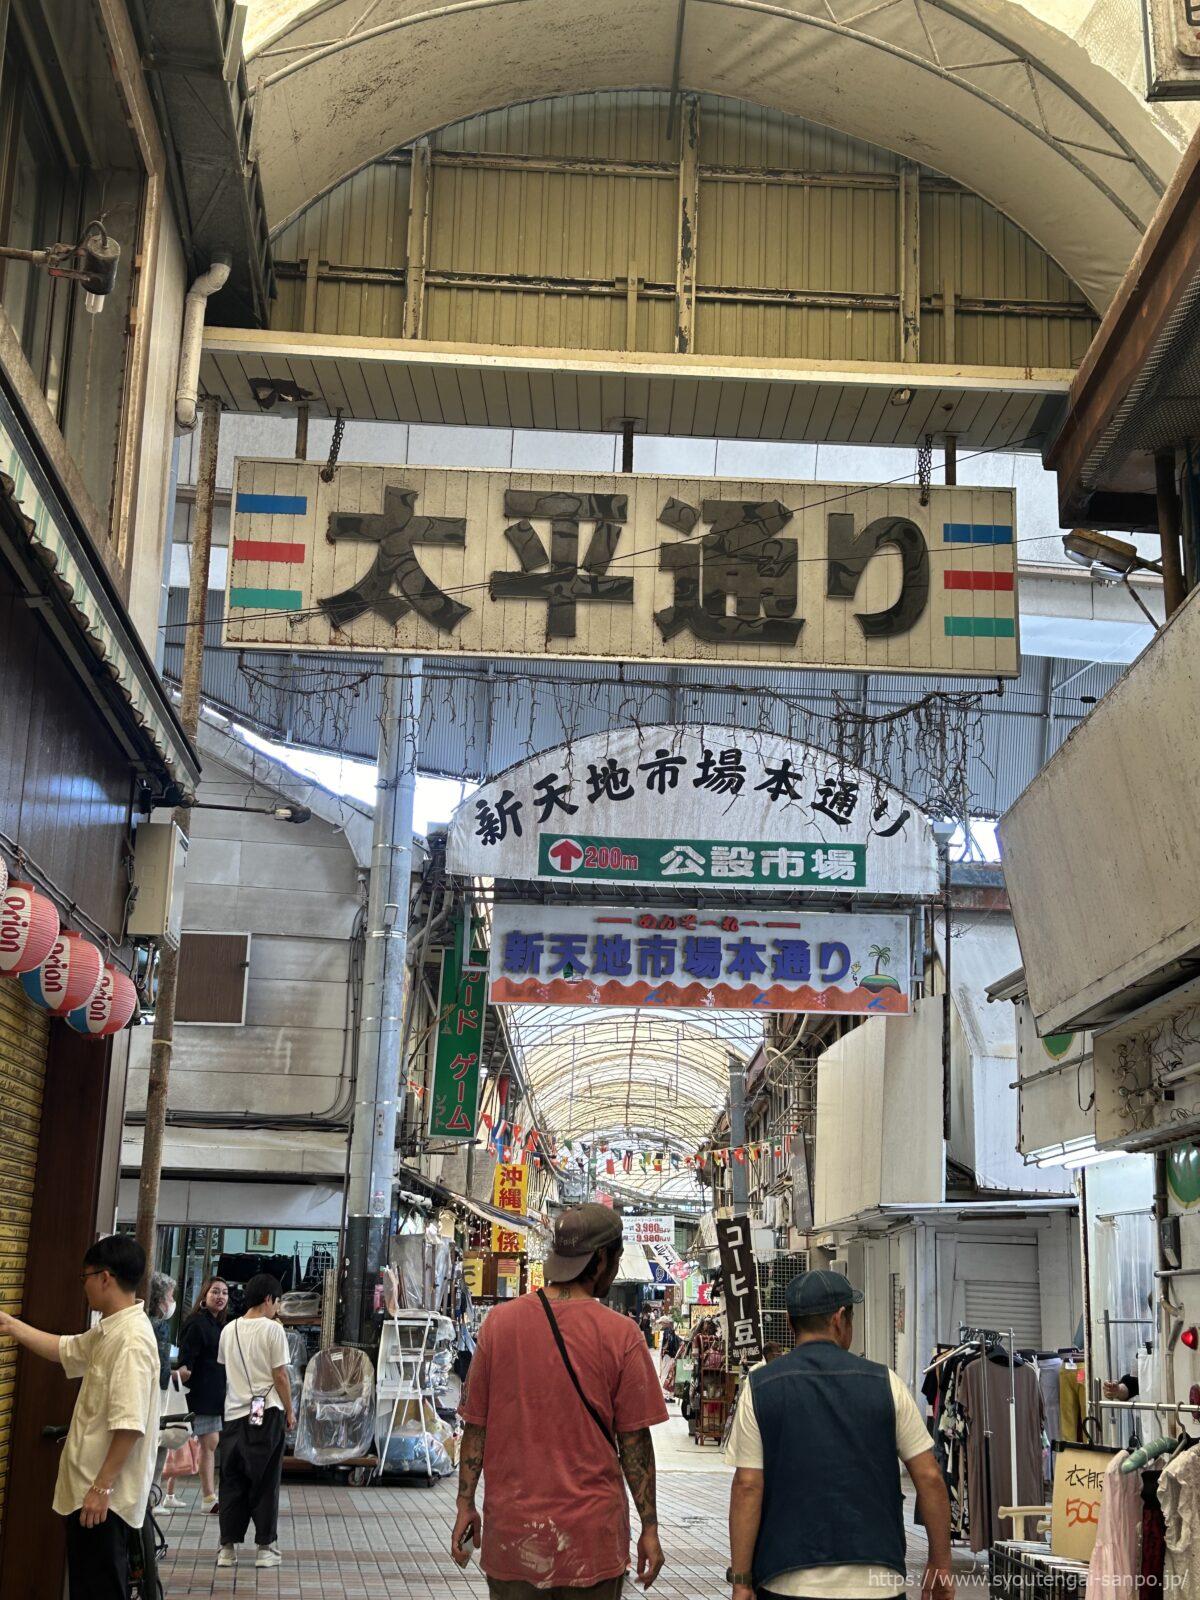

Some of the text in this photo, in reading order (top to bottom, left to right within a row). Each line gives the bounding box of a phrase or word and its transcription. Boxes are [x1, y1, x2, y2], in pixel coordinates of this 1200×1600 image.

[317, 485, 930, 647] 太平通り
[475, 748, 911, 846] 新天地市場本通り
[583, 846, 638, 871] 200m
[659, 845, 856, 881] 公設市場
[503, 930, 851, 983] 新天地市場本通り
[445, 1052, 478, 1132] ゲーム
[725, 1225, 757, 1346] コーヒー豆
